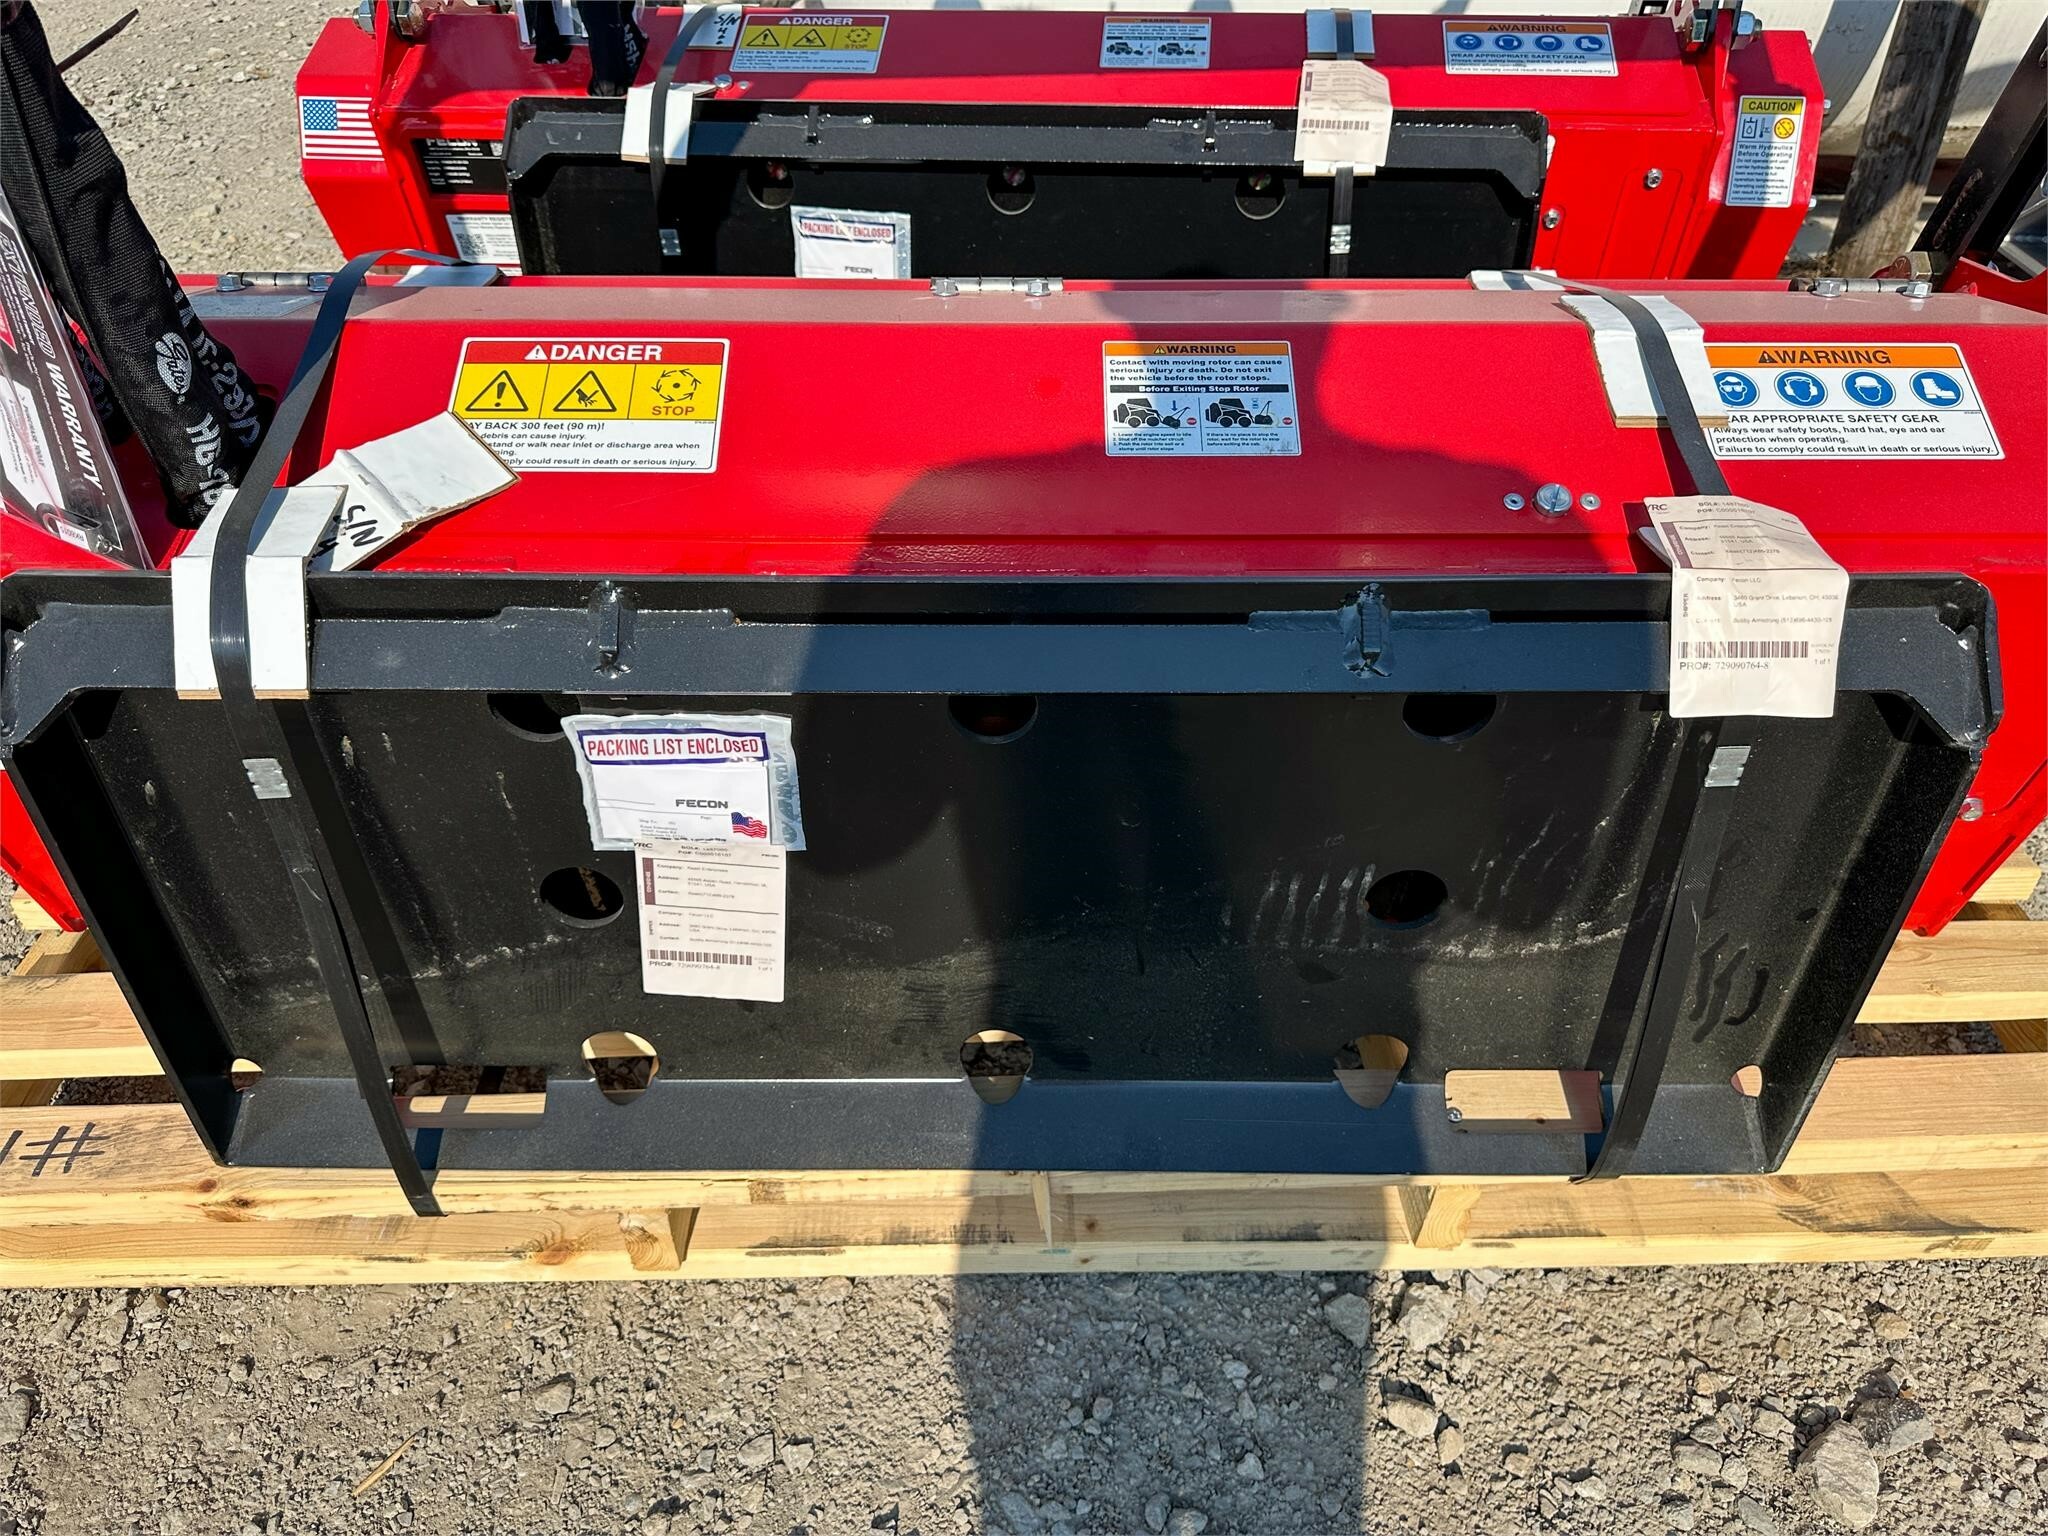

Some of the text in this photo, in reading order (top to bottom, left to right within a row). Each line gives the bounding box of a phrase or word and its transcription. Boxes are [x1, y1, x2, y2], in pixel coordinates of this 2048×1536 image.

[793, 18, 853, 26] DANGER
[1748, 102, 1796, 111] CAUTION
[804, 222, 891, 238] PACKING LT ENCLOSED
[551, 344, 662, 361] DANGER
[1167, 345, 1236, 354] WARNING
[1775, 350, 1891, 364] WARNING
[157, 337, 190, 393] Gates
[652, 406, 695, 416] STOP
[46, 361, 103, 490] WARRANTY
[468, 422, 604, 431] AY BACK 300 feet (90 m)!
[1714, 426, 1748, 434] Always
[1777, 426, 1807, 434] safety
[1809, 426, 1841, 434] boots,
[559, 432, 586, 440] injury.
[607, 442, 651, 450] discharge
[1768, 446, 1804, 454] comply
[670, 458, 697, 466] injury.
[1680, 662, 1768, 670] PRO#: 729090764-8
[587, 738, 758, 756] PACKING LIST ENCLOSED
[675, 799, 728, 809] FECON
